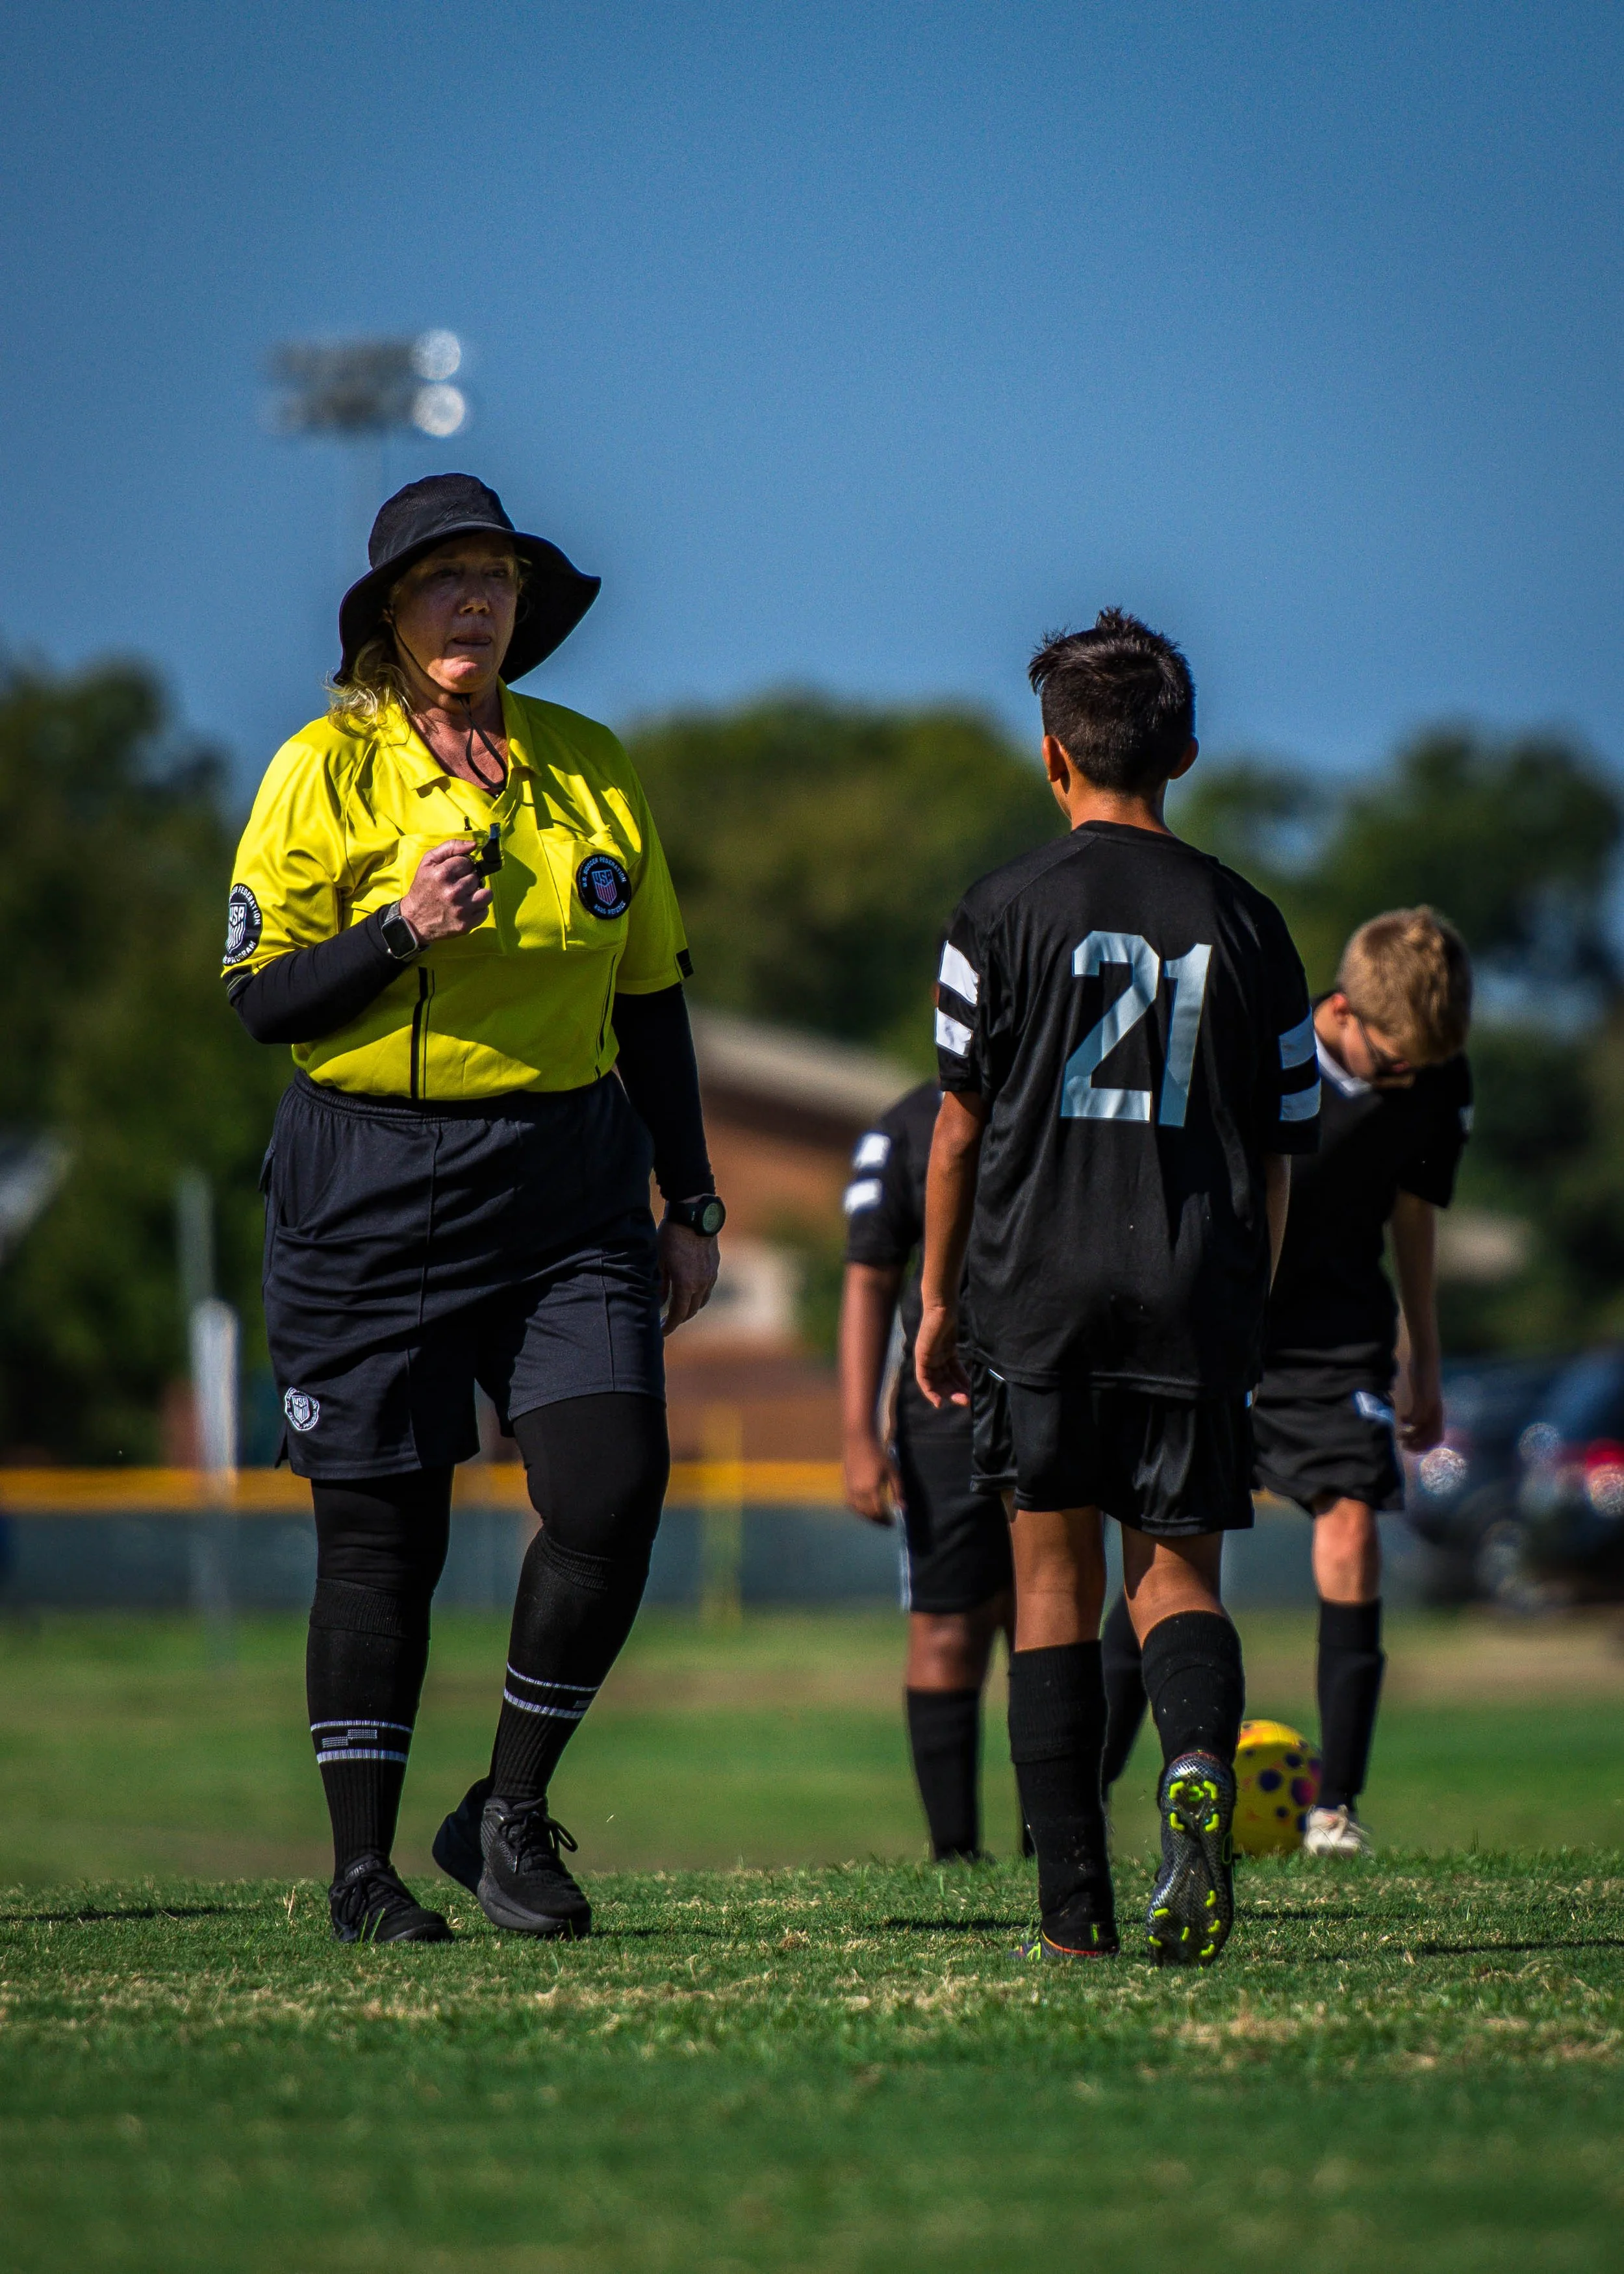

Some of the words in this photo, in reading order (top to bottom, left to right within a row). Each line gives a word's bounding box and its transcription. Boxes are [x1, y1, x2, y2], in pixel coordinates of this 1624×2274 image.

[583, 857, 598, 875] SOCCER
[600, 857, 627, 883] FEDERATION
[593, 871, 613, 885] USA
[229, 906, 245, 926] USA
[238, 885, 261, 925] FEDERATION
[227, 941, 257, 964] PROGRAM
[1060, 930, 1212, 1128] 21
[294, 1397, 307, 1408] USA
